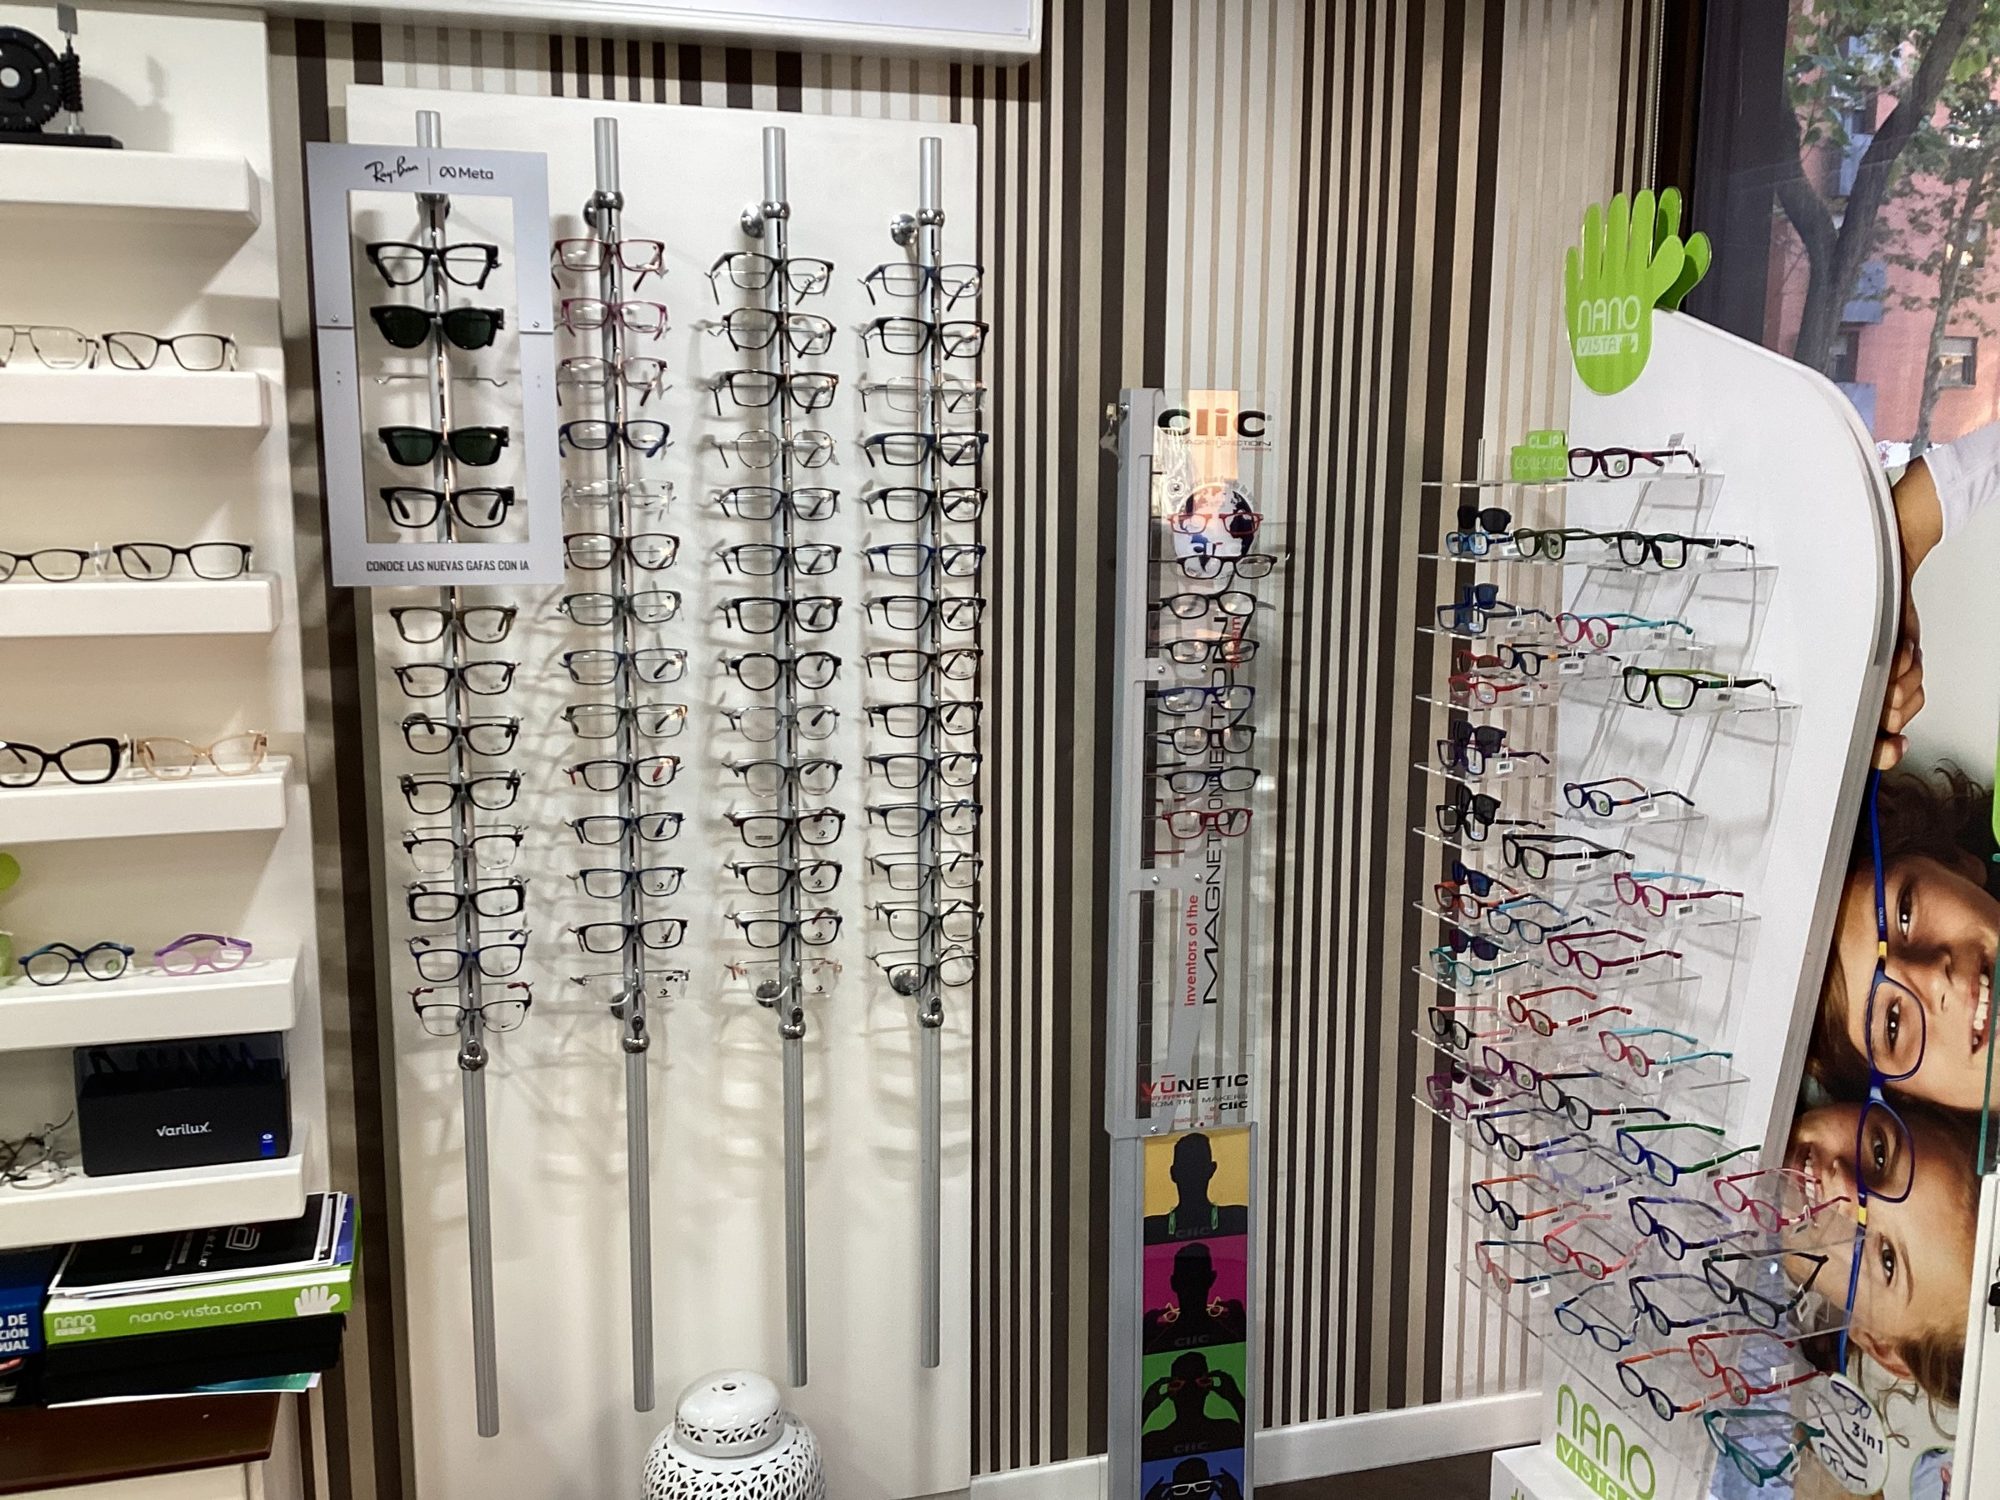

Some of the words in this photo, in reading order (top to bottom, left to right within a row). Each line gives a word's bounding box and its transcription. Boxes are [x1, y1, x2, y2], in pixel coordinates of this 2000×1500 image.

[364, 156, 419, 183] Ray-Ban
[458, 166, 494, 180] Meta
[1578, 336, 1617, 354] VISTA
[366, 560, 405, 572] CONOCE
[407, 560, 424, 571] LAS
[427, 560, 464, 571] NUEVAS
[466, 559, 496, 571] GAFAS
[498, 559, 518, 571] CON
[520, 560, 529, 571] IA
[1186, 895, 1198, 918] the
[1186, 923, 1197, 936] of
[1184, 940, 1198, 1007] inventors
[8, 1313, 28, 1327] DE
[129, 1301, 262, 1325] nano-vista.com
